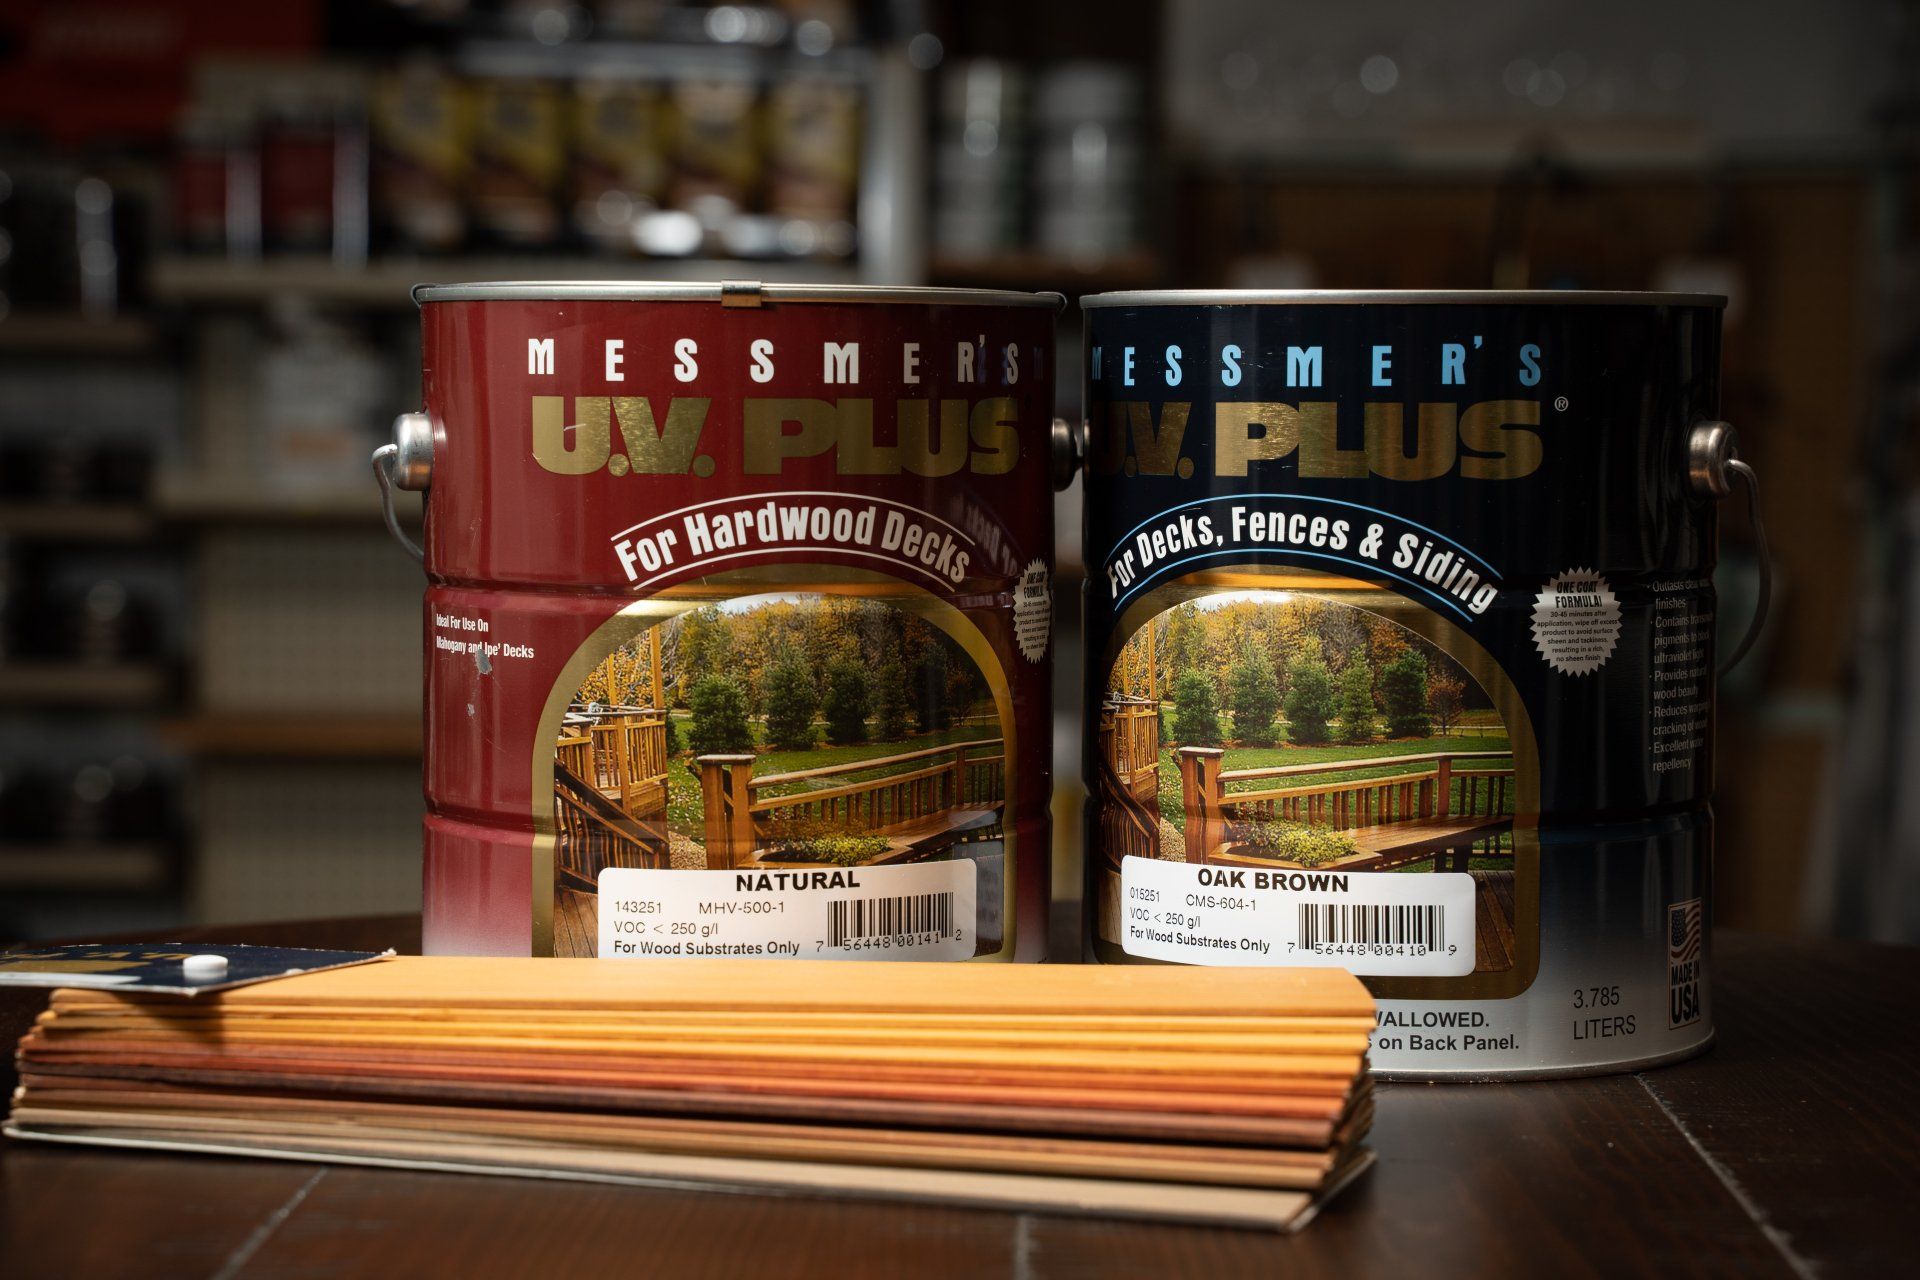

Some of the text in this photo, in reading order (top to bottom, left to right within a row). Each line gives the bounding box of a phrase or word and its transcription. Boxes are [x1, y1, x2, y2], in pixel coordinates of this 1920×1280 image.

[528, 335, 1019, 384] MESSMER'S
[1091, 336, 1542, 387] MESSMER'S
[531, 395, 1020, 477] U.V. PLUS
[1214, 399, 1544, 482] PLUS
[614, 527, 677, 582] For
[683, 501, 877, 557] Hardwood
[880, 509, 971, 584] Decks
[1106, 506, 1499, 616] For Decks, Fences & Siding
[1557, 581, 1598, 593] ONE COAT
[1652, 580, 1684, 593] Outlasts
[1555, 595, 1603, 608] FORMULA!
[436, 613, 489, 633] Ideal For Use On
[1537, 620, 1574, 628] application,
[1655, 614, 1690, 629] Contains
[1542, 629, 1567, 637] product
[436, 635, 467, 655] Mahogany
[503, 643, 535, 659] Decks
[1552, 646, 1579, 654] resulting
[1654, 669, 1689, 682] Provides
[1653, 686, 1677, 700] wood
[1654, 704, 1688, 718] Reduces
[1653, 722, 1687, 736] cracking
[1653, 738, 1689, 754] Excellent
[736, 871, 861, 892] NATURAL
[1197, 868, 1349, 892] OAK BROWN
[615, 901, 785, 915] 143251 MHV-500-1
[1130, 886, 1257, 912] 015251 CMS-604-1
[1129, 907, 1201, 930] VOC < 250 g/l
[614, 921, 719, 937] VOC < 250 g/l
[614, 940, 801, 956] For Wood Substrates Only
[815, 929, 963, 953] 7 56448 00141 2
[1130, 926, 1271, 955] For Wood Substrates Only
[1287, 942, 1457, 957] 7 56448 00410 9
[1671, 962, 1692, 986] MADE
[1573, 985, 1621, 1009] 3.785
[1671, 981, 1700, 1024] USA
[1573, 1015, 1636, 1040] LITERS
[1379, 1038, 1403, 1050] on
[1410, 1034, 1457, 1050] Back
[1463, 1034, 1520, 1050] Panel.
